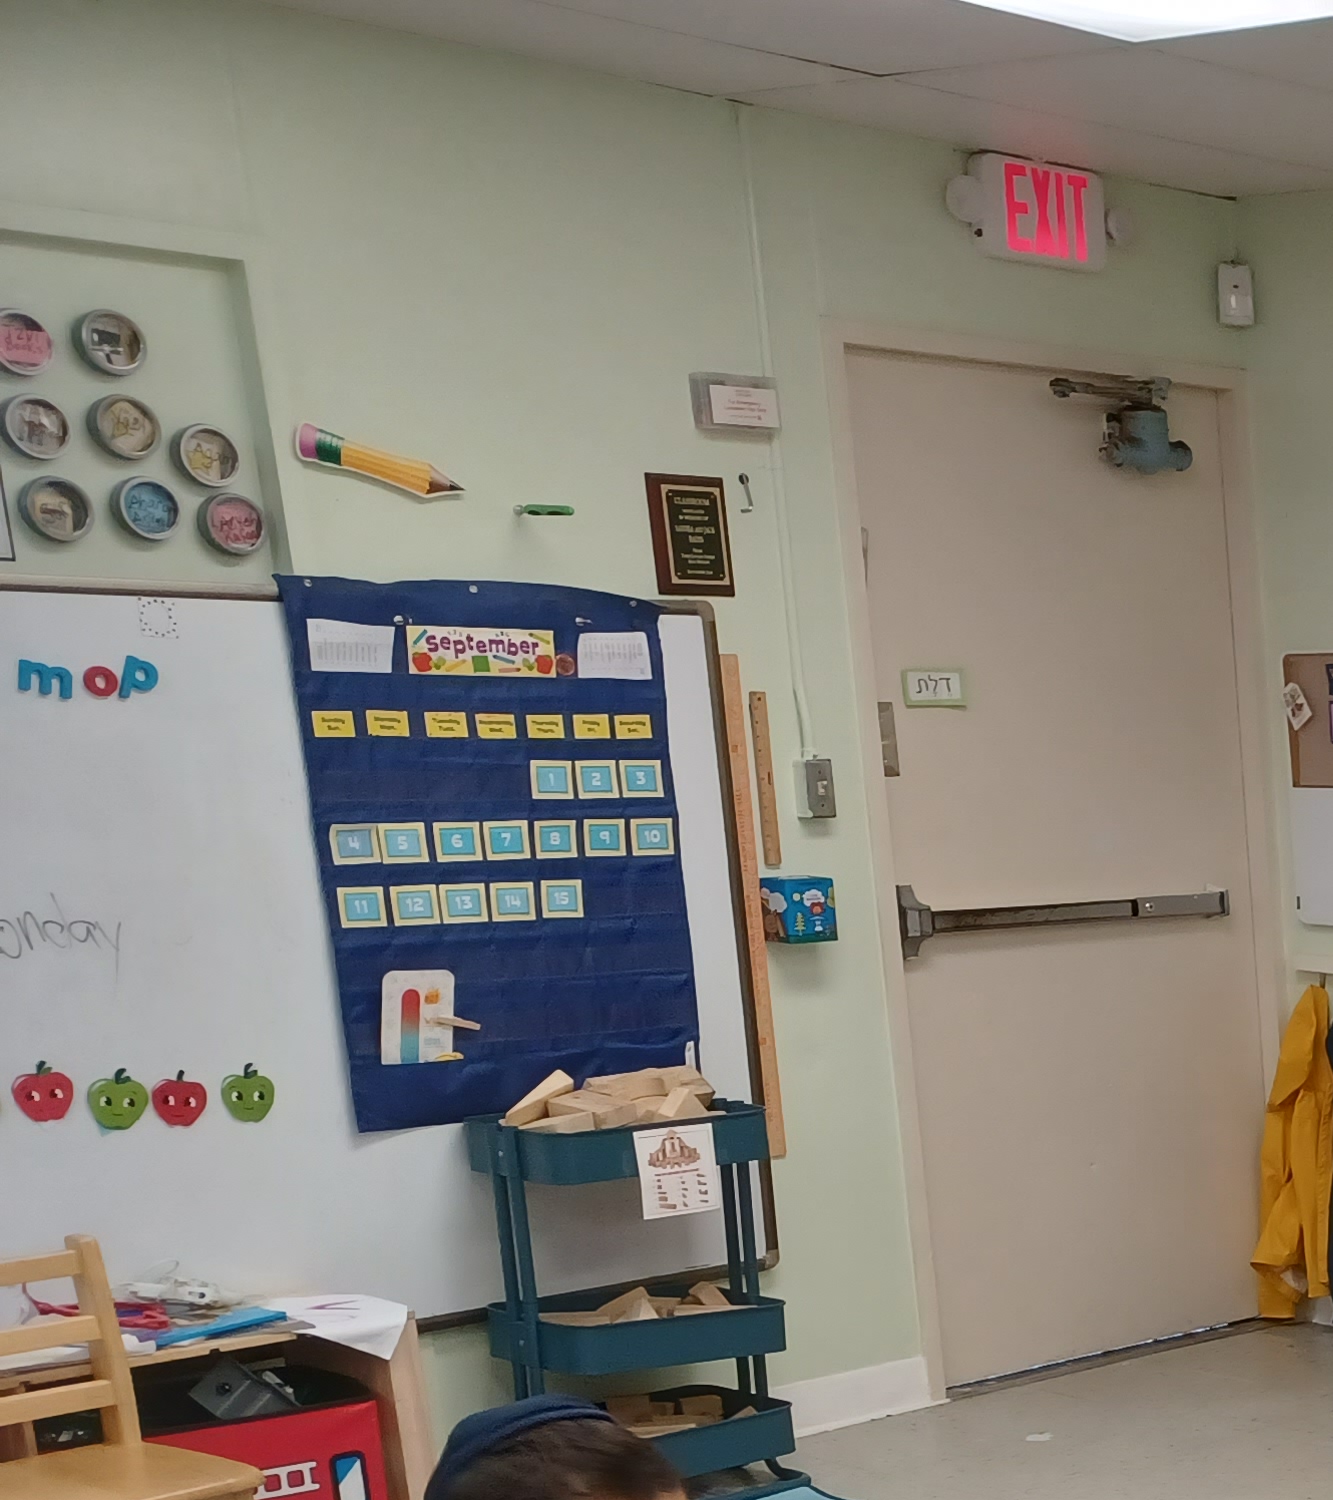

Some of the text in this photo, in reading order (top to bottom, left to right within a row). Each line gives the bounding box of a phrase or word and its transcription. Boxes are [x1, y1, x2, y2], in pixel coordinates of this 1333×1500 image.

[1004, 163, 1088, 262] EXIT
[17, 655, 159, 699] mop
[549, 772, 555, 786] 1
[591, 773, 601, 787] 2
[636, 772, 647, 785] 3
[348, 836, 360, 850] 4
[397, 836, 409, 850] 5
[451, 834, 463, 848] 6
[501, 833, 511, 847] 7
[549, 832, 560, 845] 8
[599, 830, 610, 844] 9
[644, 829, 660, 844] 10
[405, 898, 424, 912] 12
[455, 896, 472, 910] 13
[504, 895, 521, 908] 14
[554, 892, 569, 905] 15
[354, 900, 369, 914] 11
